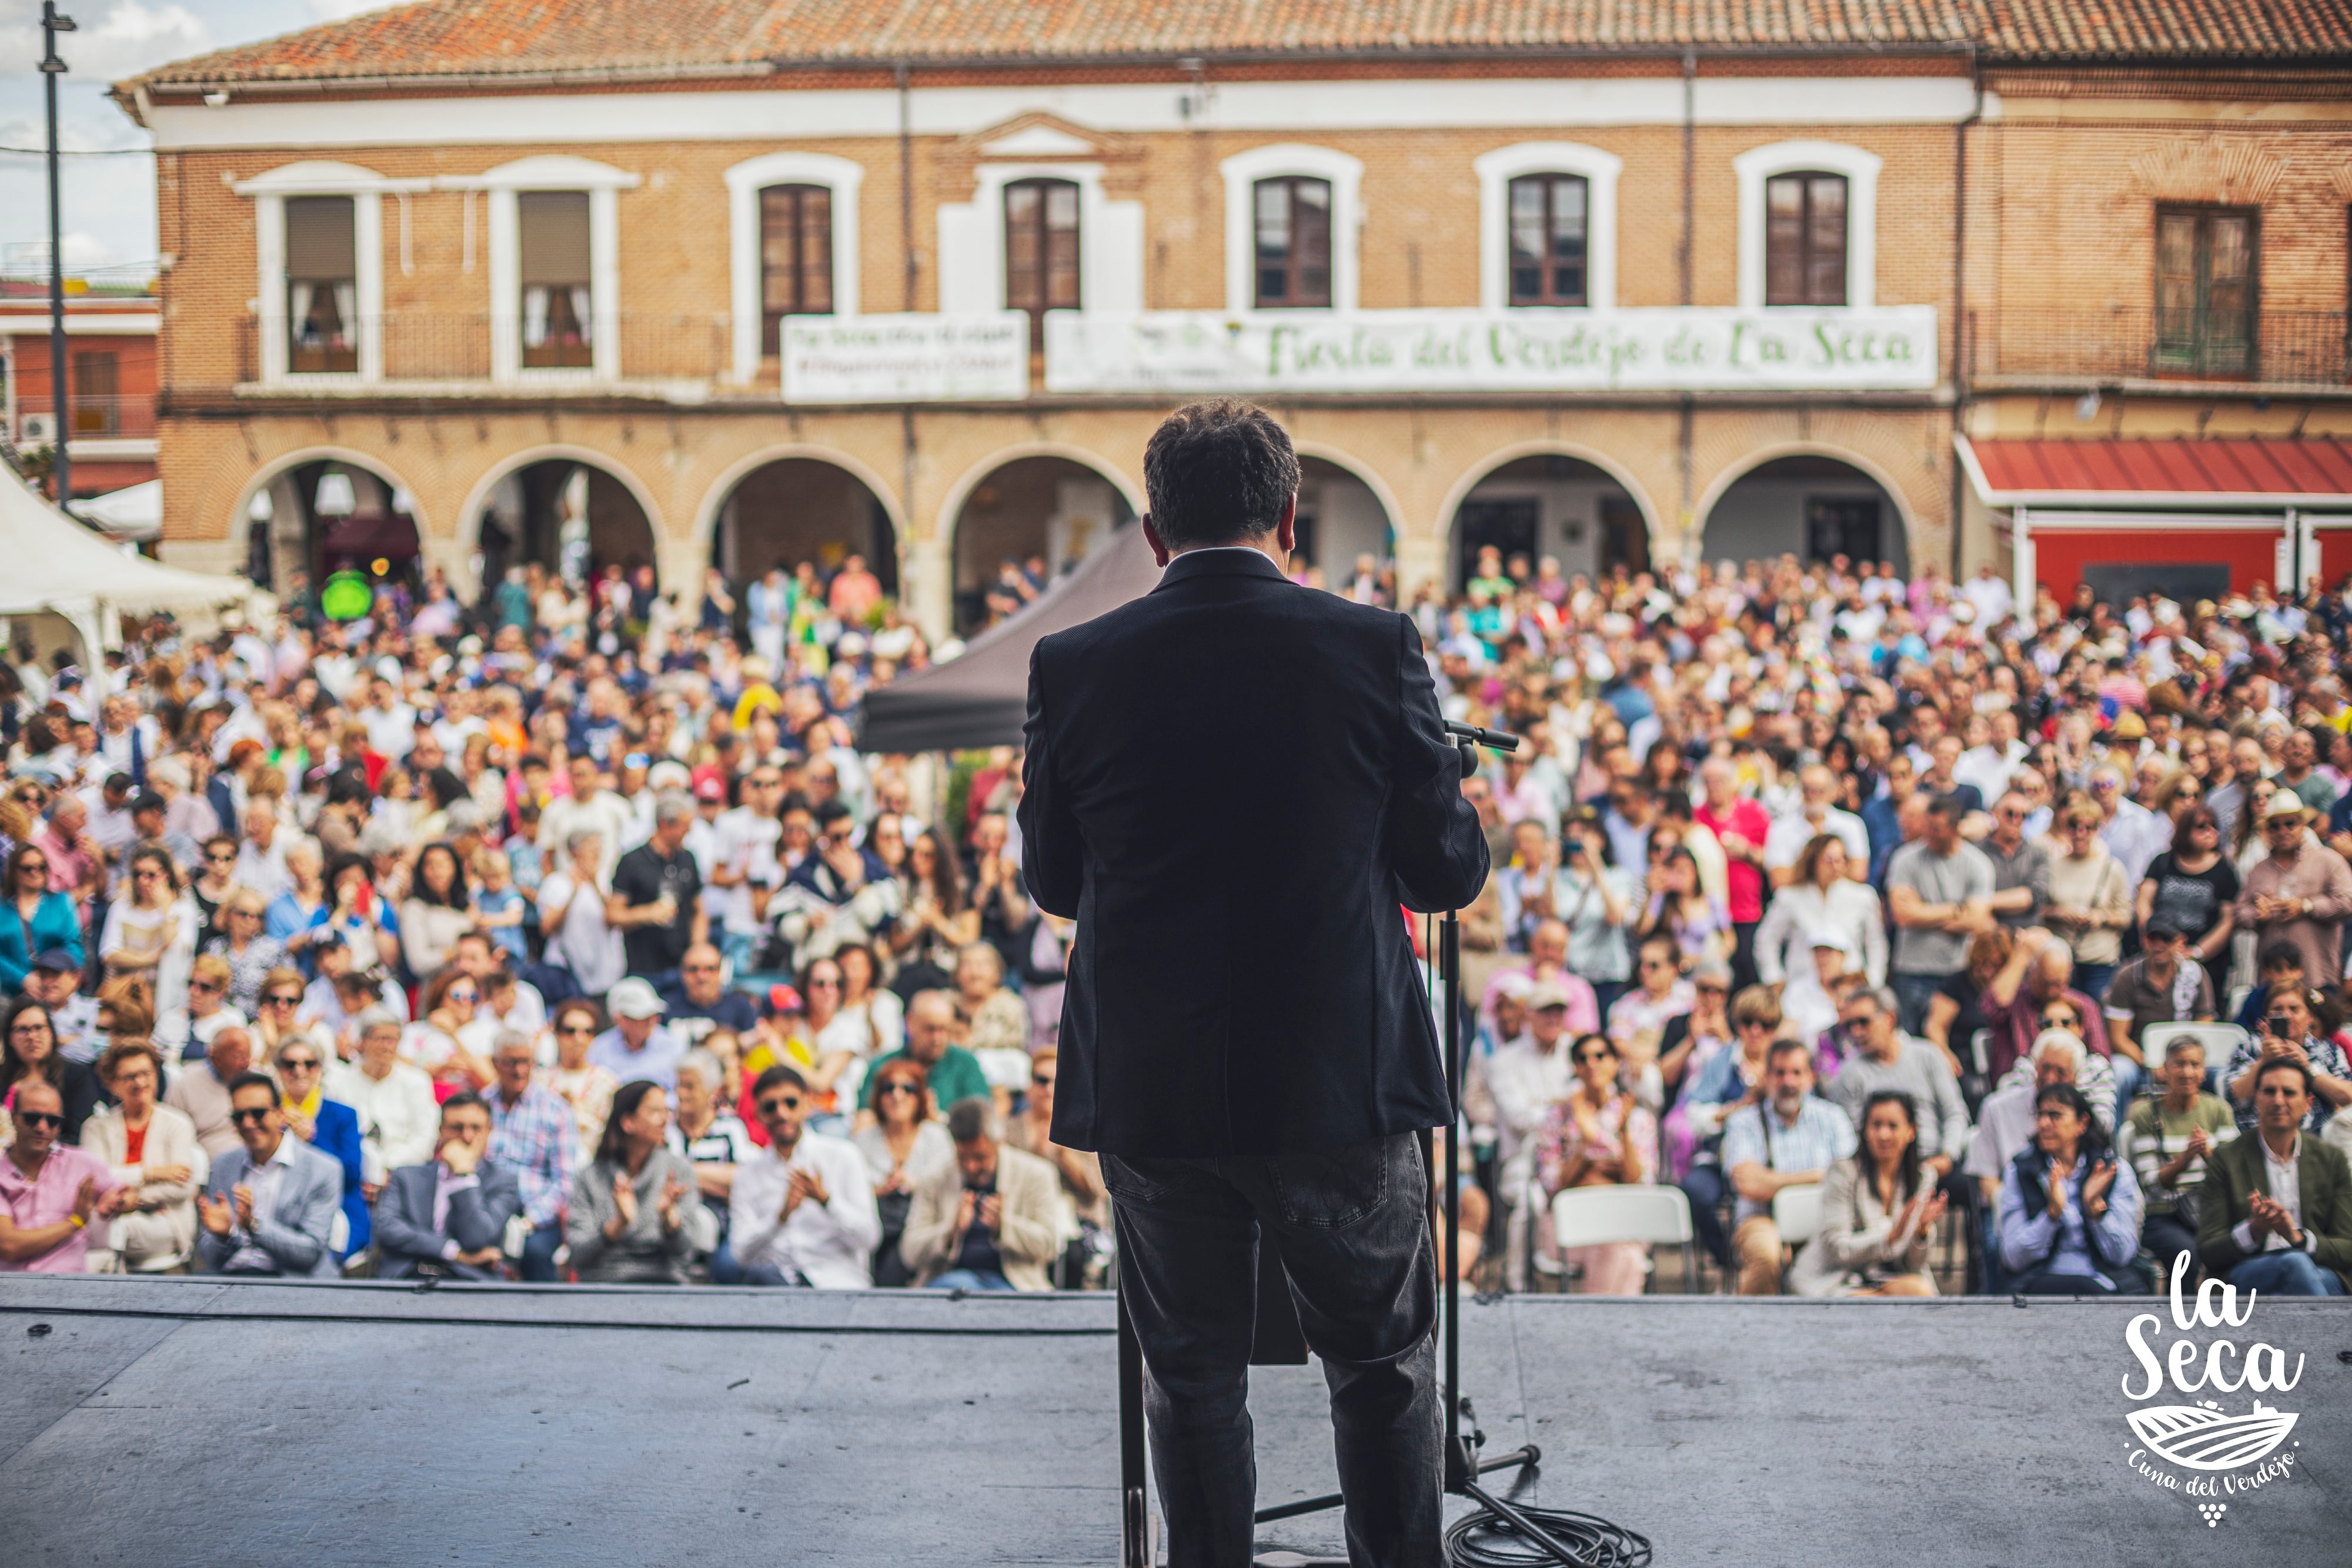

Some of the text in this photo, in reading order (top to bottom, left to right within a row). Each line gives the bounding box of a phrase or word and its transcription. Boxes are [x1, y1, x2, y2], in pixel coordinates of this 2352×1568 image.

[1267, 318, 1916, 385] Fiesta del Verdejo de La Seca
